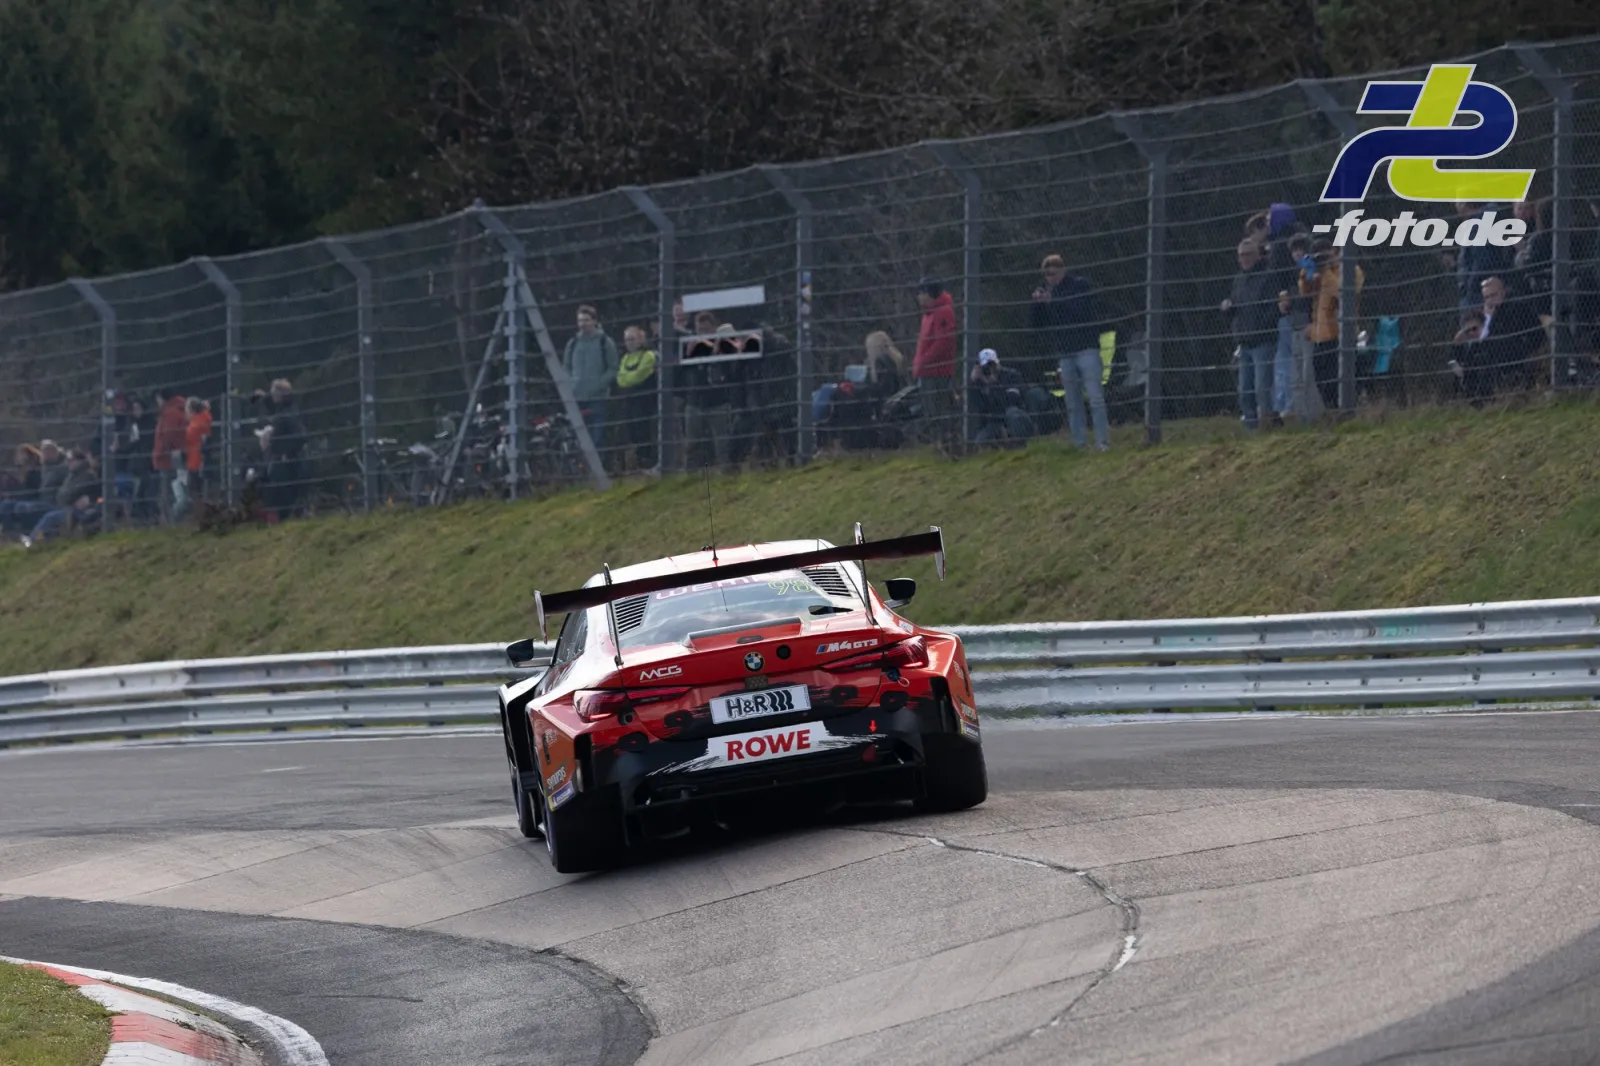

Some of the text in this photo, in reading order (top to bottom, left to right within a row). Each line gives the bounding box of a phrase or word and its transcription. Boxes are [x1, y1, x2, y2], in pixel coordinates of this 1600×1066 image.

[768, 578, 813, 596] 98
[853, 639, 878, 649] GT3
[640, 665, 682, 681] MCG
[726, 694, 768, 718] H&R
[724, 729, 811, 761] ROWE
